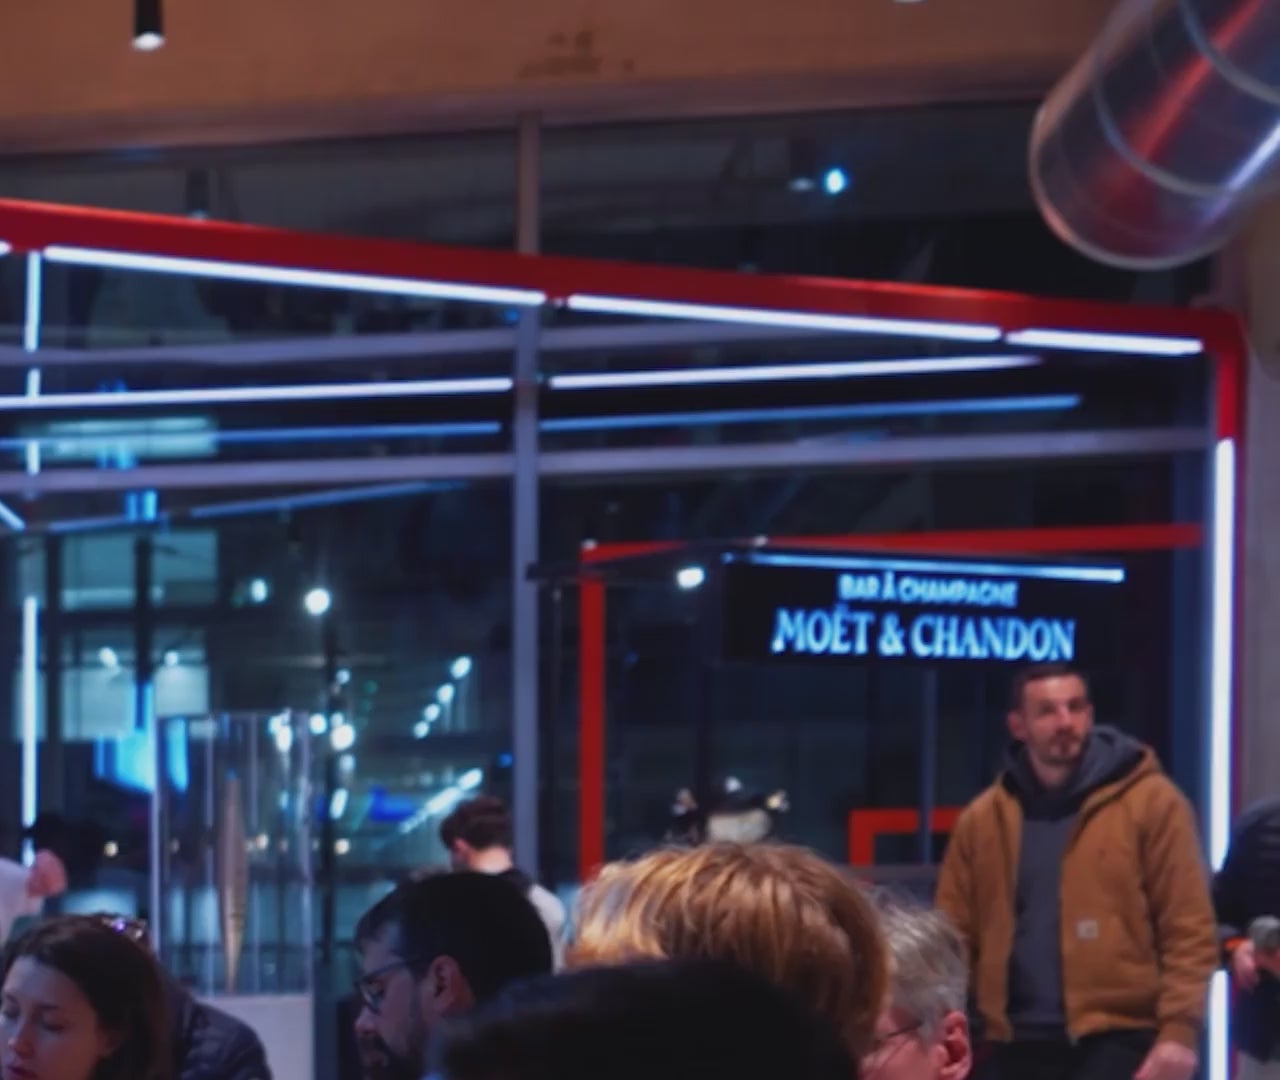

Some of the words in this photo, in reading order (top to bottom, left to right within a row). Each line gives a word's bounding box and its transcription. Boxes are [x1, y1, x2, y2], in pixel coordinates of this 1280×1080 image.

[839, 573, 880, 601] BAR
[898, 576, 1018, 608] CHAMPAGNE
[771, 602, 874, 654] MOËT
[878, 611, 905, 656] &
[911, 613, 1075, 661] CHANDON
